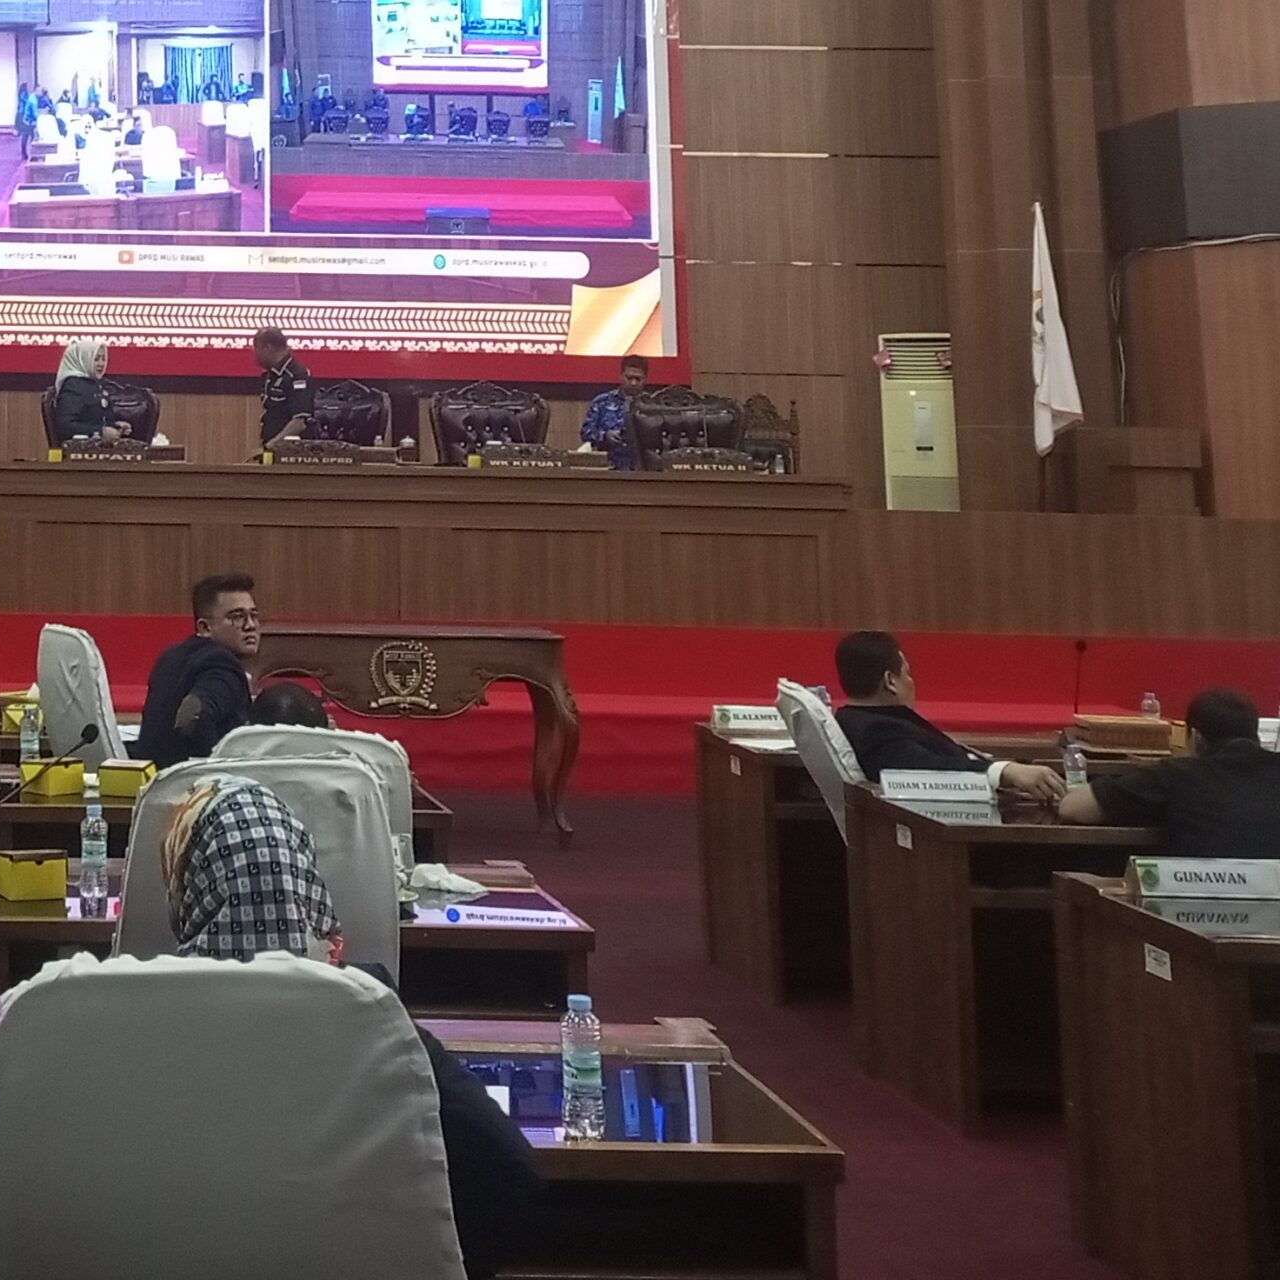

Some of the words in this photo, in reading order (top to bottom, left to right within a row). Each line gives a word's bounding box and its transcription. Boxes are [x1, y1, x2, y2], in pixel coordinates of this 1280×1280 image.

[70, 452, 142, 462] BUPATI
[280, 456, 320, 464] KETUA
[672, 463, 693, 471] WK
[694, 463, 737, 472] KETUA
[887, 781, 921, 790] IDHAM
[1173, 871, 1248, 884] GUNAWAN
